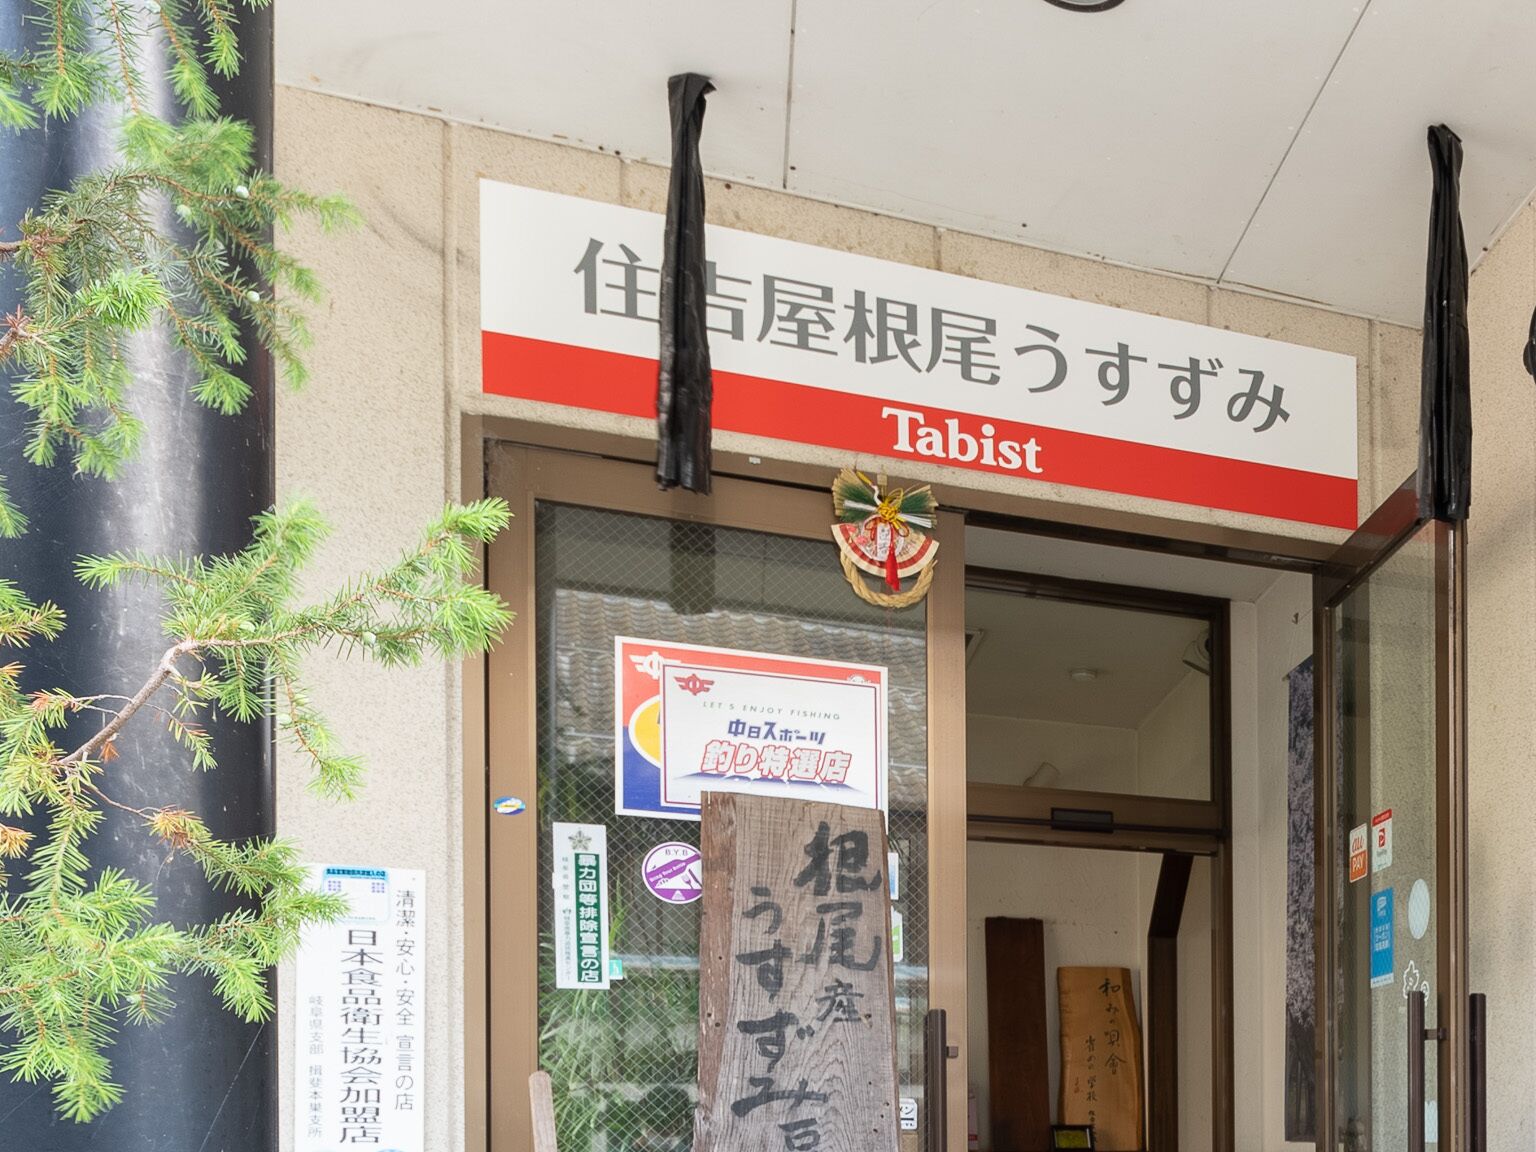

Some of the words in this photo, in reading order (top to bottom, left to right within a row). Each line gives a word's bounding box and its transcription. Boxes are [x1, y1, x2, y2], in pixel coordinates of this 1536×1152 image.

[881, 407, 1043, 475] Tabist
[727, 719, 826, 745] 中日スポーツ
[743, 705, 783, 715] ENJOY
[790, 709, 841, 720] FISHING
[701, 739, 852, 784] 釣り特選店
[794, 821, 882, 1022] 根尾産
[339, 928, 383, 1144] 日本食品衛生協会加盟店
